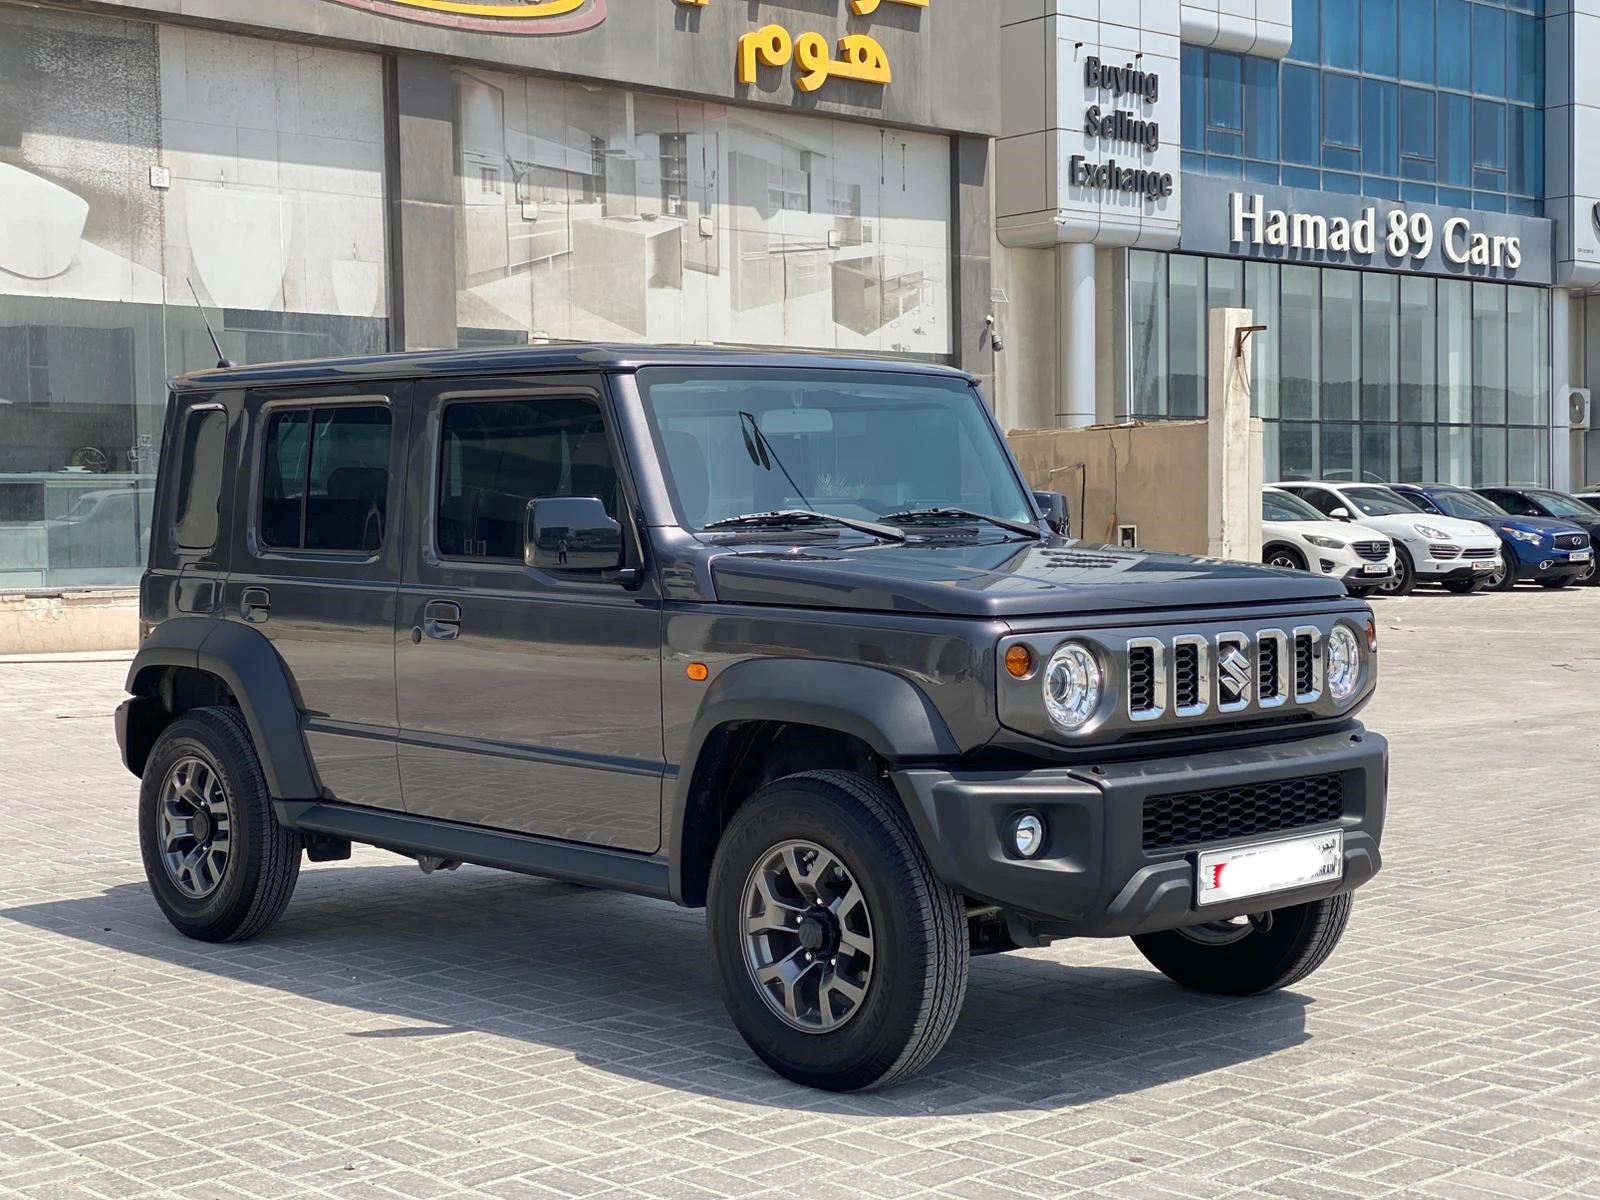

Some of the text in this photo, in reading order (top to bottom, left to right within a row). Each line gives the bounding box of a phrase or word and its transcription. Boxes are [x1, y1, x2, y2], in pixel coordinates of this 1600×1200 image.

[740, 24, 891, 92] هوم
[1085, 56, 1158, 104] Buying
[1085, 105, 1158, 152] Selling
[1070, 155, 1173, 200] Exchange
[1231, 191, 1522, 269] Hamad 89 Cars
